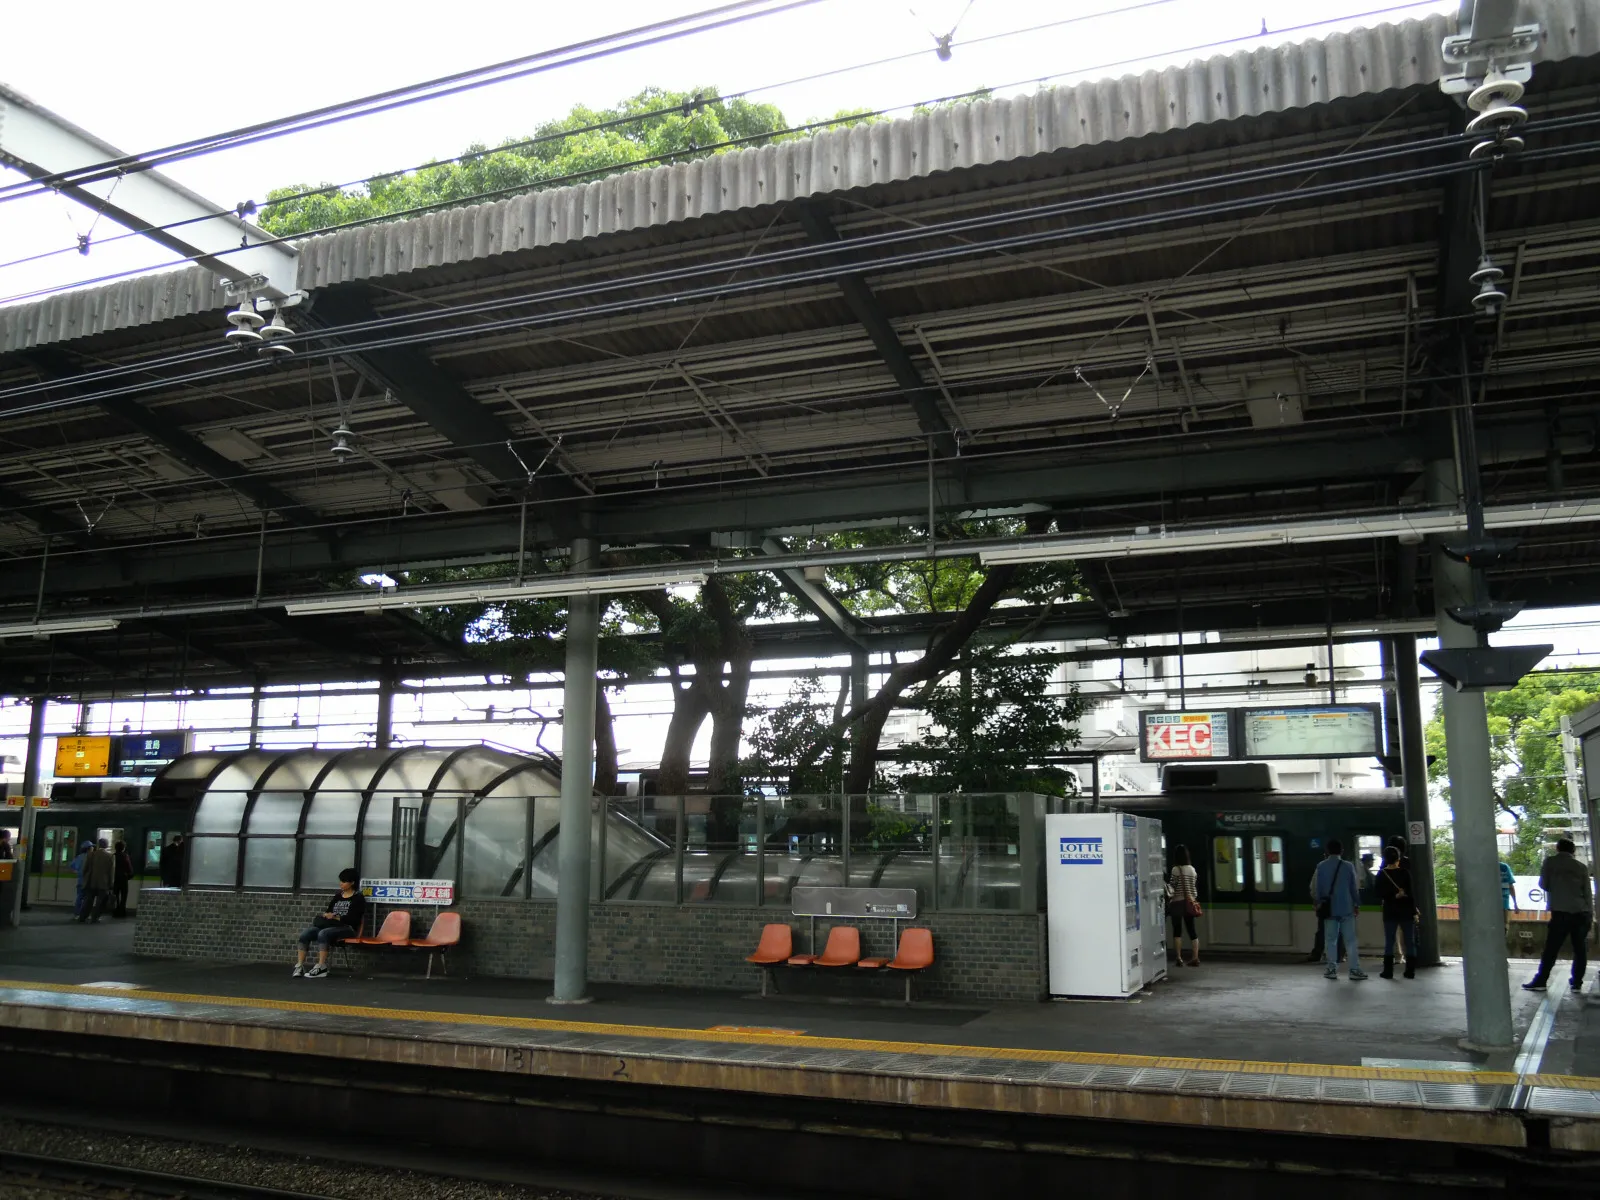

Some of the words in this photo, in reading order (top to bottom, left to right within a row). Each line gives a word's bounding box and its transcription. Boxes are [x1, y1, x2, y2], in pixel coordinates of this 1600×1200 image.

[1147, 724, 1211, 750] KEC
[1224, 814, 1276, 822] KEIHAN
[1060, 843, 1103, 853] LOTTE
[613, 1059, 631, 1078] 2
